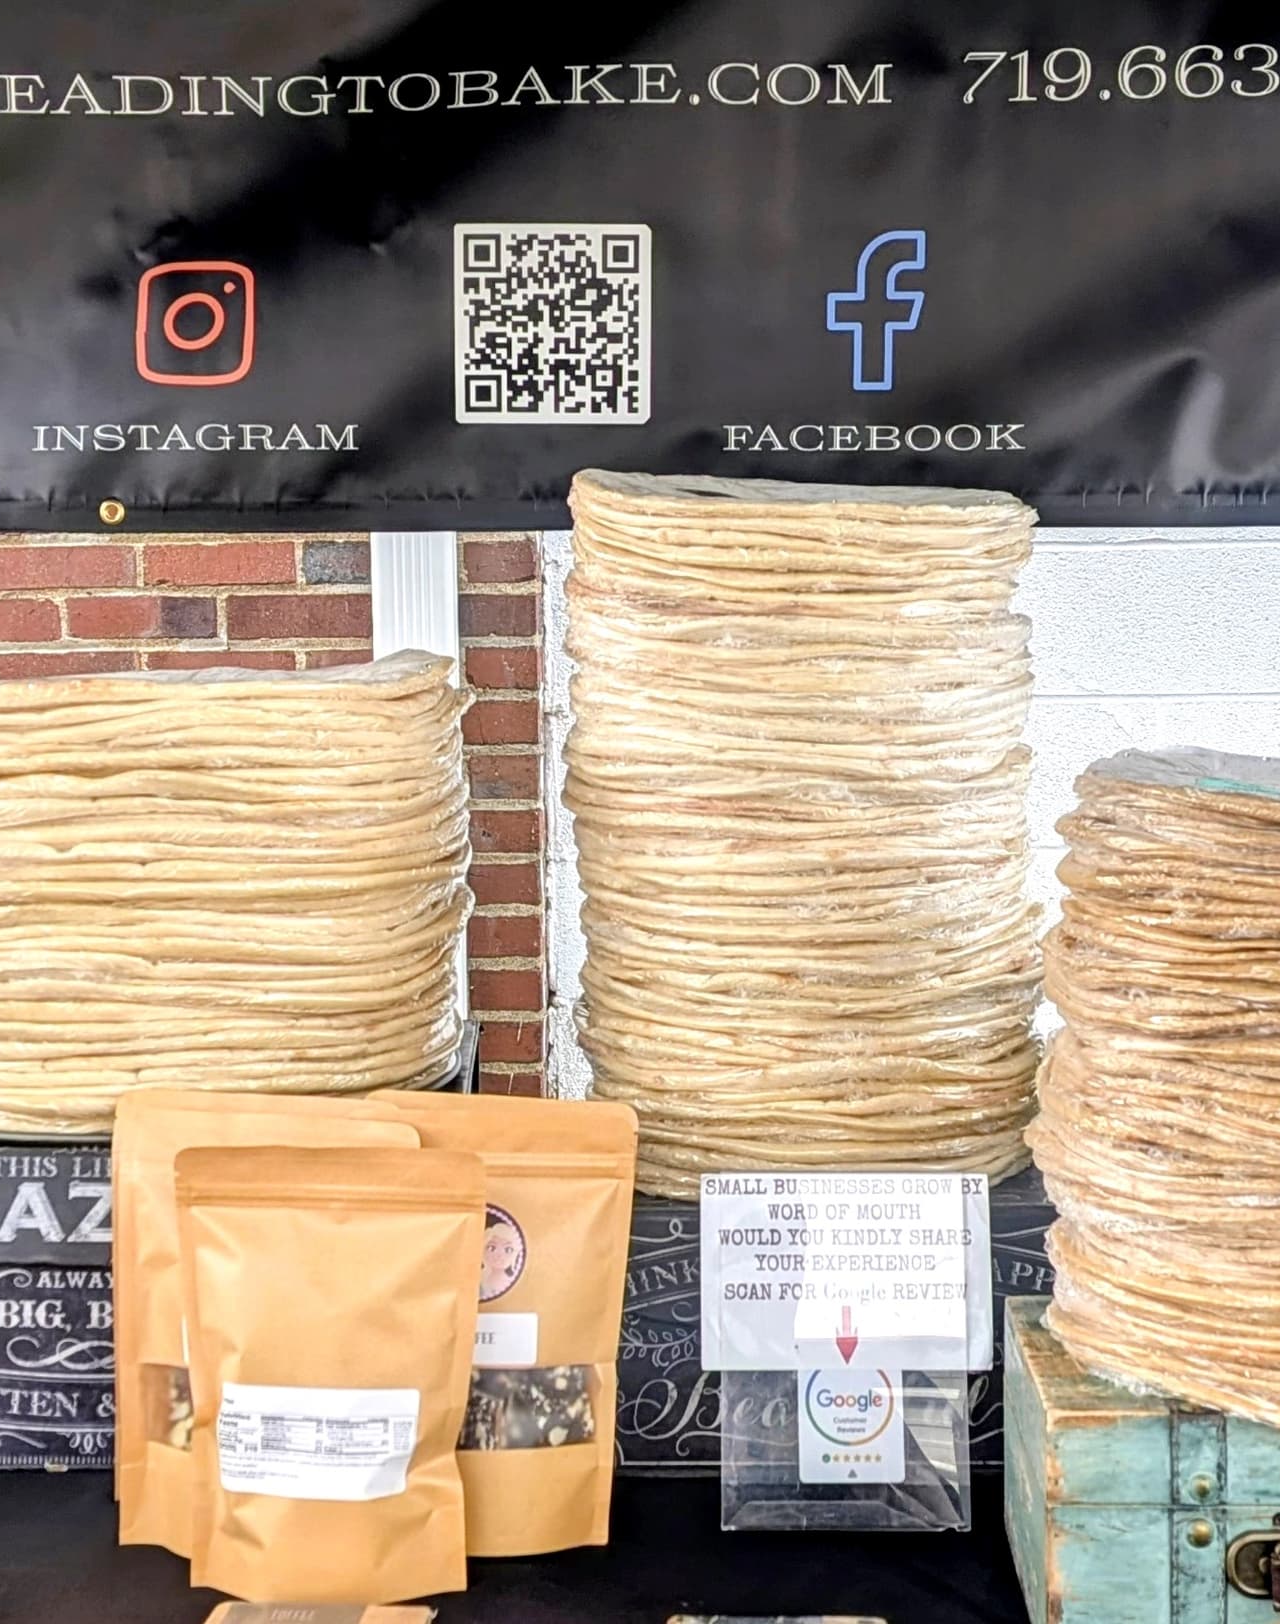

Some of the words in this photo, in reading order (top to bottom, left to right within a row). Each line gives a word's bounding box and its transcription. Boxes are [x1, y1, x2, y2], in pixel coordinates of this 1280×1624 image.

[31, 423, 360, 452] INSTAGRAM
[722, 423, 1027, 452] FACEBOOK
[704, 1178, 768, 1196] SMALL
[774, 1178, 896, 1196] BUSINESSES
[901, 1178, 954, 1195] GROW
[961, 1178, 984, 1196] BY
[767, 1203, 819, 1221] WORD
[824, 1203, 851, 1220] OF
[856, 1203, 922, 1220] MOUTH
[718, 1228, 782, 1247] WOULD
[787, 1229, 825, 1247] YOU
[830, 1229, 904, 1246] KINDLY
[908, 1228, 973, 1246] SHARE
[754, 1254, 806, 1272] YOUR
[811, 1254, 937, 1272] EXPERIENCE
[723, 1282, 772, 1301] SCAN
[778, 1282, 817, 1301] FOR
[892, 1283, 968, 1301] REVIEW
[816, 1388, 883, 1412] Google
[836, 1426, 866, 1434] Reviews
